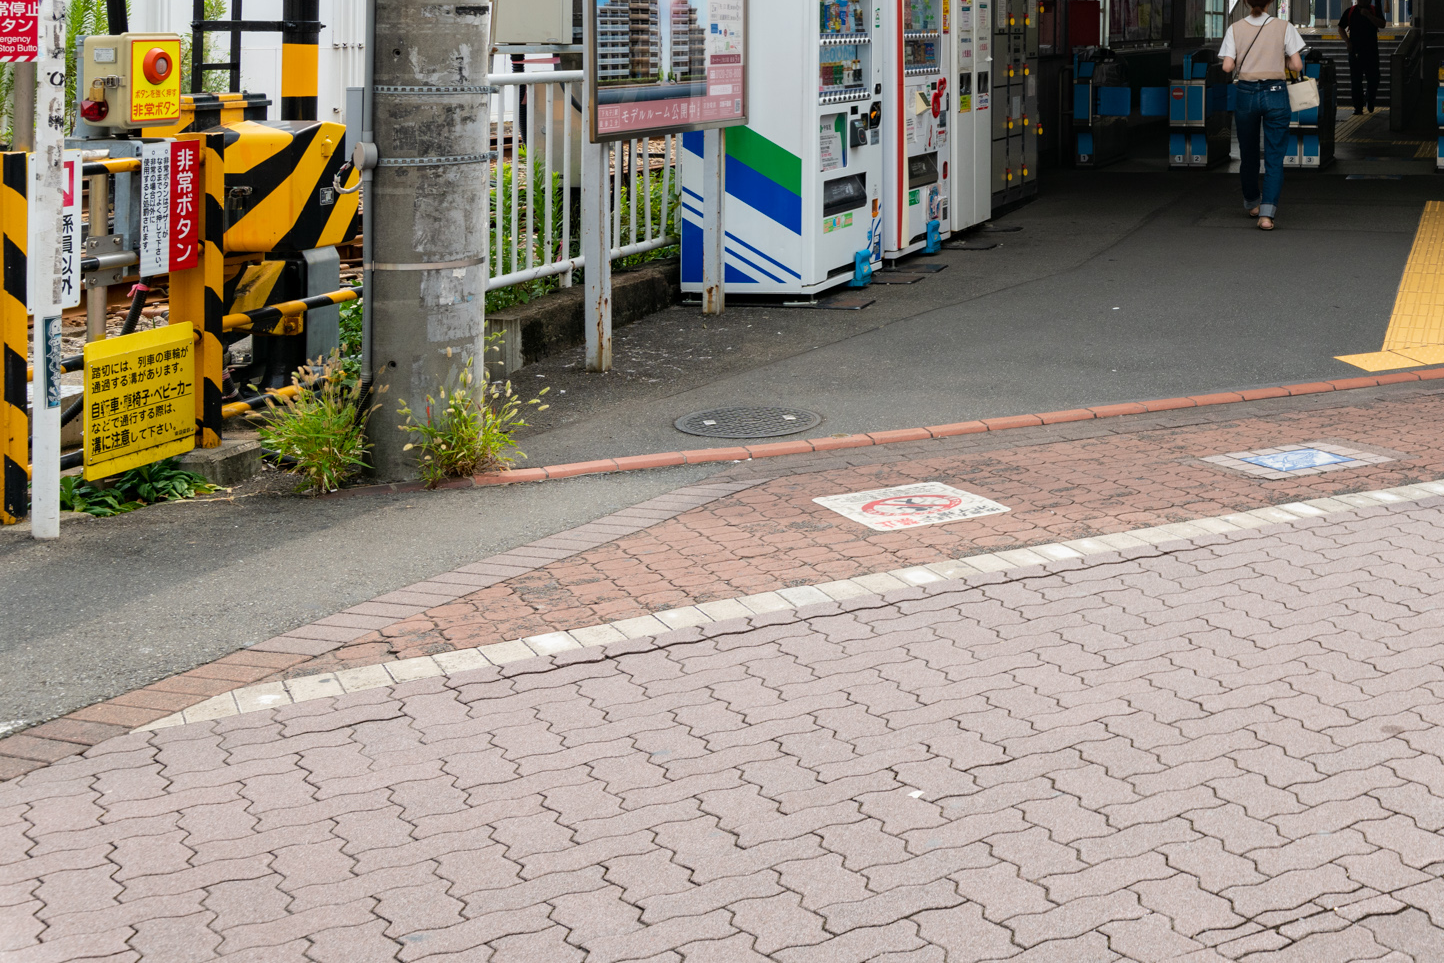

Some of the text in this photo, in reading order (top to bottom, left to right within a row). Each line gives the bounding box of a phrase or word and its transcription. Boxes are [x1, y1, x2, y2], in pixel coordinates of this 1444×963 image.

[0, 18, 34, 33] タン
[17, 44, 38, 53] Butto
[135, 89, 177, 99] ボタンを強く押す
[133, 101, 179, 117] 非常ボタン
[621, 102, 696, 124] モデルルーム公開中
[155, 157, 163, 268] なるまでつよく押して下さい。
[176, 148, 194, 263] 非常ボタン
[92, 362, 184, 395] 通過する溝があります。
[92, 402, 176, 434] などで通行する際は、
[92, 422, 177, 455] 溝に注意して下さい。
